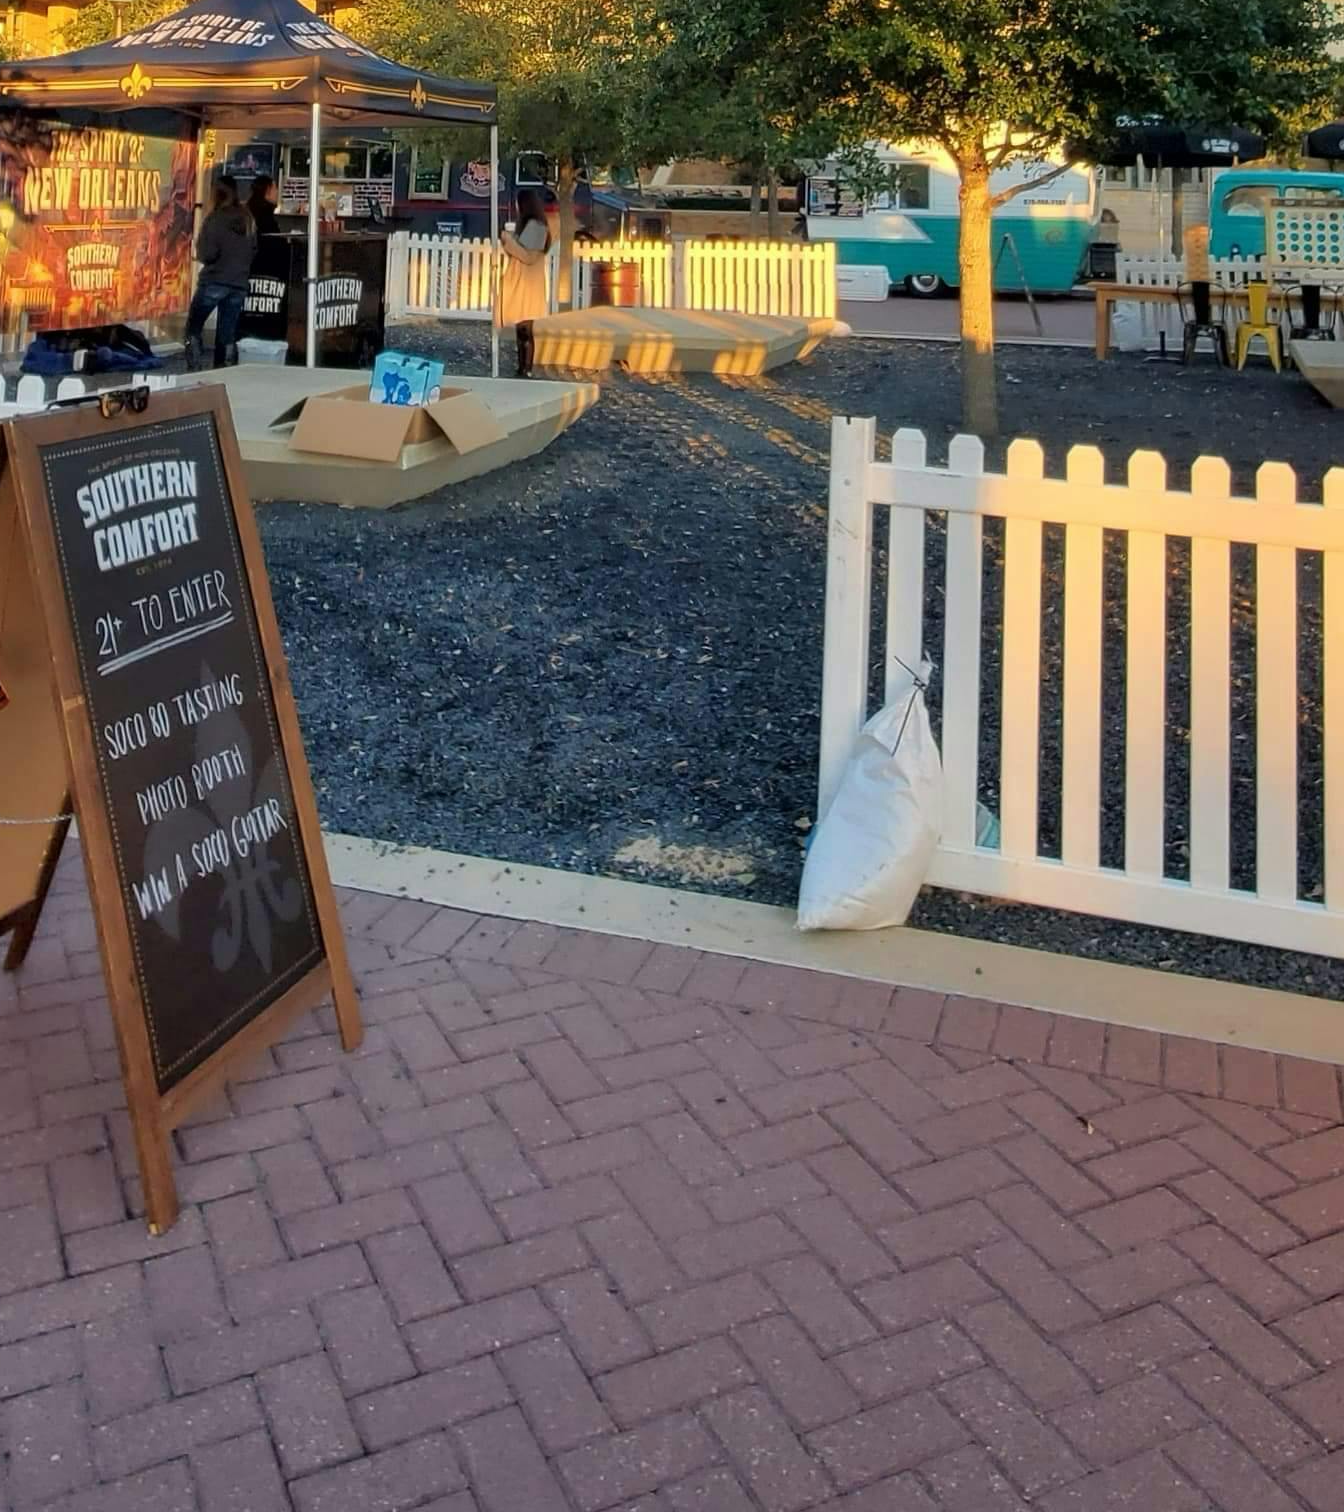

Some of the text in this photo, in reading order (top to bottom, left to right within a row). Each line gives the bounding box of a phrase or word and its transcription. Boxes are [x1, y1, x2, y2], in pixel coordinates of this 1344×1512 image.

[112, 25, 276, 48] NEW ORLEANS
[154, 14, 266, 32] THE SPIRIT OF
[79, 127, 125, 164] SPIRIT
[24, 166, 162, 216] NEW ORLEANS
[67, 243, 120, 270] SOUTHERN
[69, 268, 115, 292] COMFORT
[248, 278, 286, 298] THERN
[242, 296, 281, 314] MFORT
[77, 460, 198, 529] SOUTHERN
[93, 502, 200, 572] COMFORT
[95, 569, 233, 657] 21+ TO ENTER
[104, 673, 244, 760] SOCO 80 TASTING
[136, 743, 247, 826] PHOTO BOOTH
[132, 798, 289, 921] WIN A SOCO GUITAR
